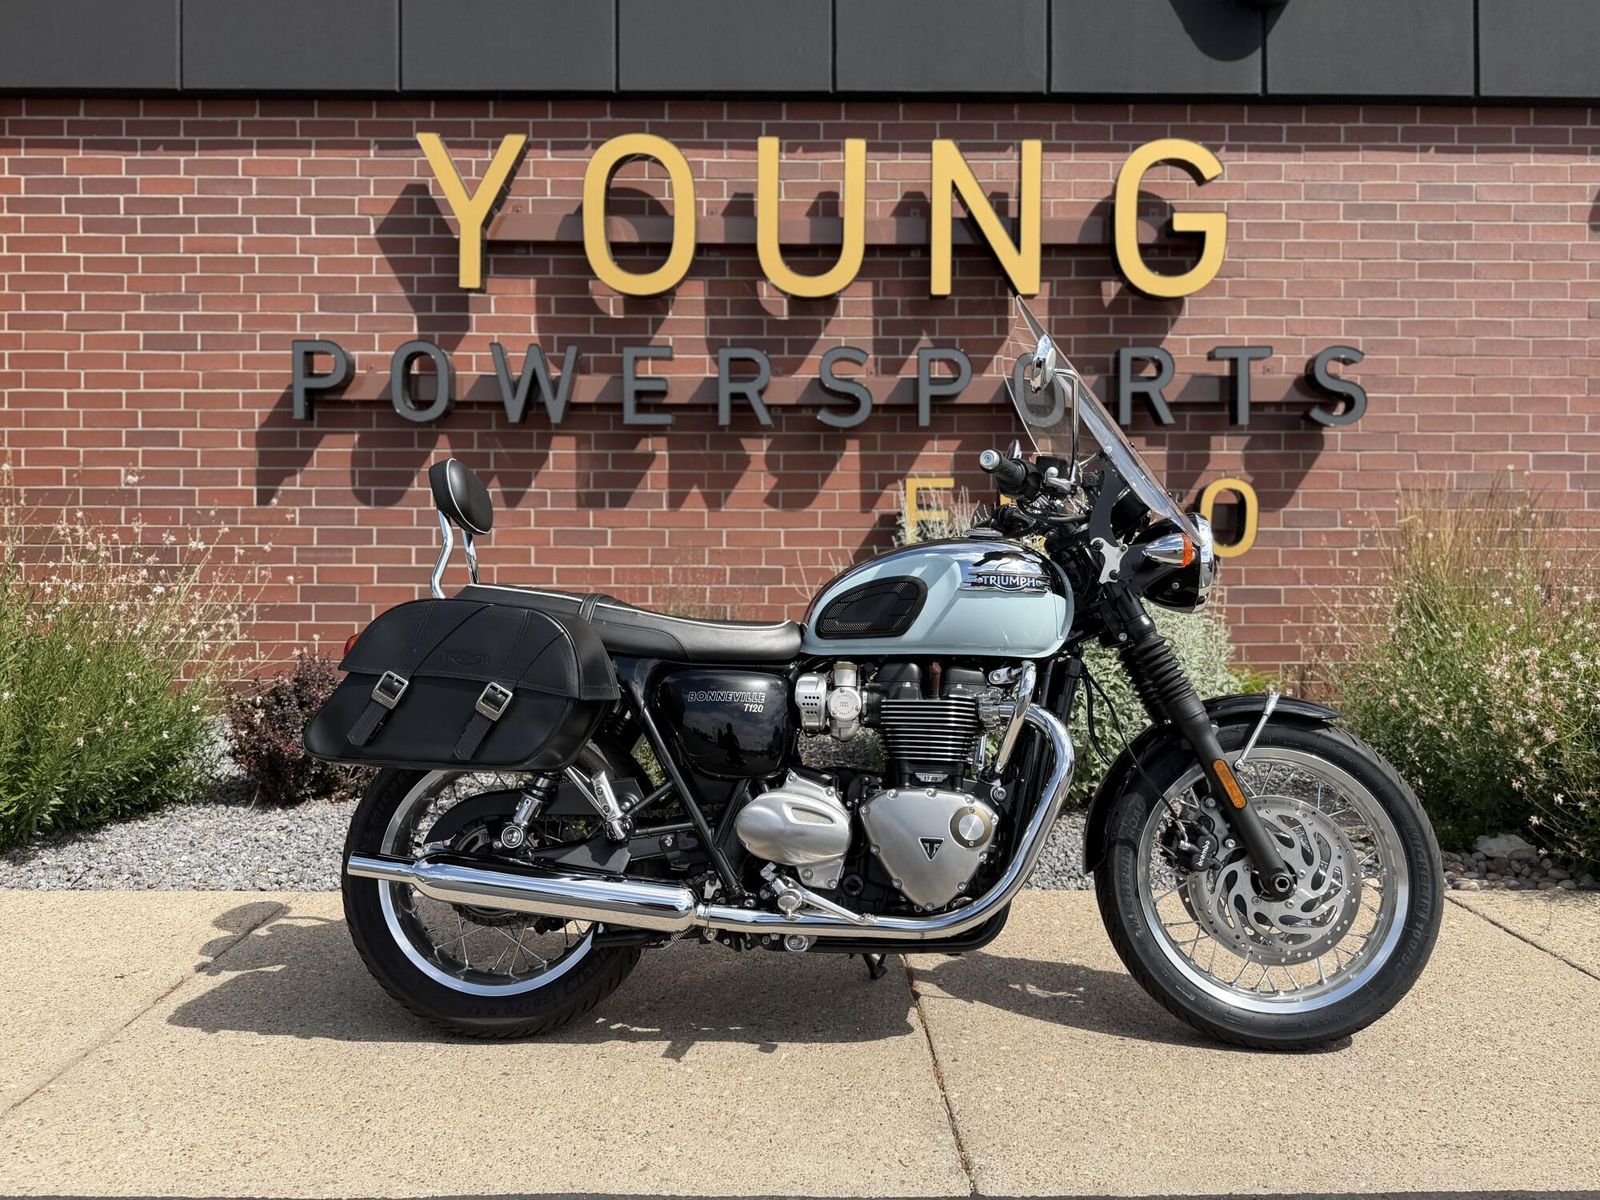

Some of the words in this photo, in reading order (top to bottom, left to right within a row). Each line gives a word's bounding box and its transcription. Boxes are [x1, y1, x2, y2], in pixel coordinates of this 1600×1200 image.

[416, 132, 1228, 298] YOUNG
[291, 339, 1368, 428] POWERSPORTS
[981, 575, 1036, 589] TRIUMPH
[687, 690, 766, 704] BONNEVILLE
[743, 703, 764, 713] T120
[1195, 840, 1211, 867] brembo
[1407, 824, 1431, 920] MICHELIN
